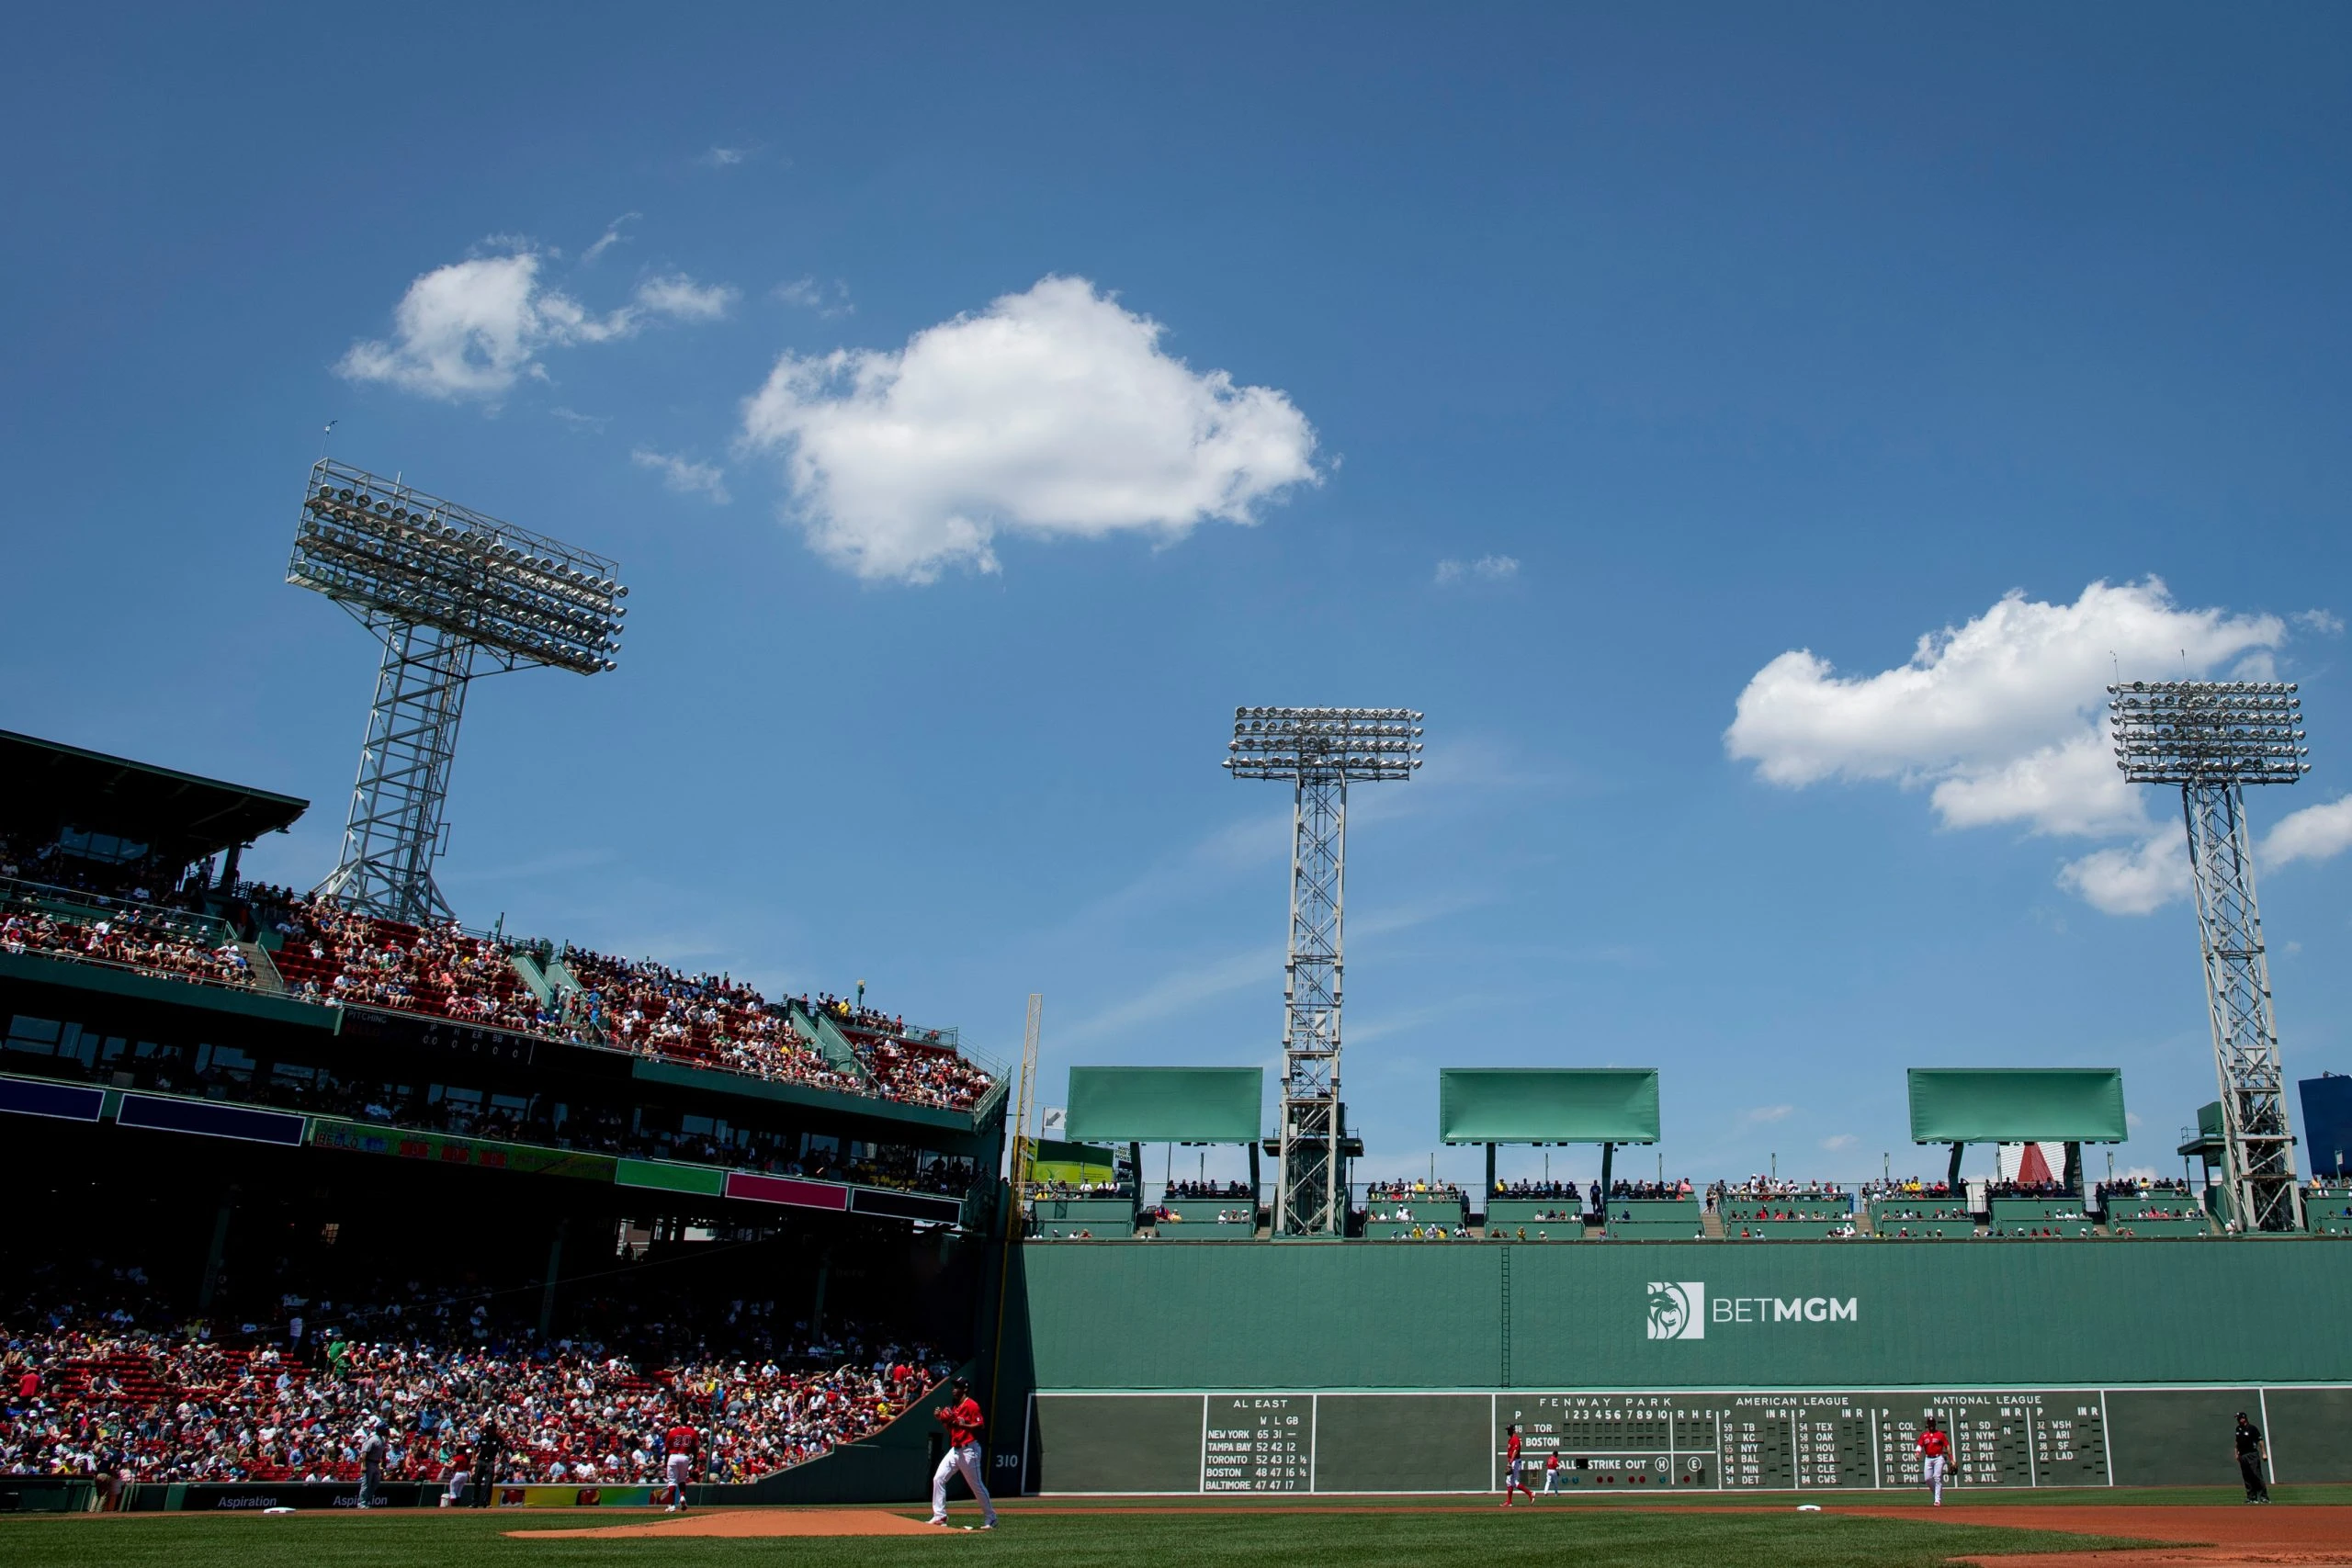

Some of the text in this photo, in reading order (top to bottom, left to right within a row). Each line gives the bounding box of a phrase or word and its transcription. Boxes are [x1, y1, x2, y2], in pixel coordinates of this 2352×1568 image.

[346, 1010, 388, 1024] PITCHING
[471, 1031, 482, 1040] ER
[492, 1034, 503, 1043] BB
[451, 1039, 458, 1049] 0
[471, 1043, 479, 1052] 0
[492, 1046, 499, 1055] 0
[513, 1049, 519, 1058] 0
[1713, 1298, 1857, 1322] BETMGM
[1540, 1398, 1670, 1406] FENWAY PARK
[1736, 1397, 1849, 1405] AMERICAN LEAGUE
[1934, 1396, 1990, 1404] NATIONAL
[1516, 1410, 1711, 1419] P 1 2 3 4 5 6 7 8 9 10 R H E
[1724, 1410, 1730, 1418] P
[1781, 1409, 1786, 1417] R
[1800, 1409, 1862, 1417] P IN R
[1883, 1409, 1888, 1417] P
[1924, 1408, 1933, 1418] IN
[1961, 1408, 2021, 1416] P IN R
[2037, 1407, 2098, 1416] P IN R
[1261, 1416, 1298, 1425] W L GB
[1534, 1424, 1552, 1432] TOR
[1743, 1423, 1755, 1431] TB
[1799, 1423, 1807, 1431] 54
[1899, 1422, 1916, 1430] COL
[1979, 1421, 1990, 1429] SD
[2037, 1421, 2045, 1429] 32
[1208, 1430, 1282, 1438] NEW YORK 65 31
[1800, 1433, 1833, 1441] 58 OAK
[1900, 1432, 1916, 1440] MIL
[1961, 1432, 1969, 1440] 59
[673, 1435, 692, 1447] 20
[1526, 1438, 1559, 1447] BOSTON
[1208, 1442, 1295, 1451] TAMPA BAY 52 42 12
[1741, 1444, 1758, 1452] NYY
[1900, 1443, 1916, 1451] STL
[1979, 1442, 1994, 1450] MIA
[2058, 1441, 2069, 1450] SF
[1257, 1455, 1267, 1464] 52
[1271, 1455, 1282, 1463] 43
[1287, 1455, 1295, 1463] 12
[1741, 1454, 1758, 1462] BAL
[1817, 1454, 1835, 1462] SEA
[1902, 1453, 1917, 1461] CIN
[1980, 1452, 1994, 1461] PIT
[2040, 1451, 2073, 1461] 22 LAD
[996, 1455, 1017, 1467] 310
[1528, 1461, 1543, 1470] BAT
[1557, 1461, 1576, 1470] ALL
[1589, 1461, 1621, 1470] STRIKE
[1626, 1461, 1645, 1470] OUT
[1659, 1461, 1665, 1469] H
[1692, 1461, 1697, 1469] E
[1743, 1465, 1758, 1473] MIN
[1901, 1464, 1919, 1472] CHC
[1980, 1463, 1996, 1472] LAA
[1206, 1468, 1241, 1476] BOSTON
[1256, 1468, 1267, 1476] 48
[1271, 1468, 1281, 1476] 47
[1286, 1468, 1295, 1476] 16
[1726, 1476, 1734, 1484] 51
[1817, 1475, 1836, 1483] CWS
[1904, 1474, 1918, 1483] PHI
[1943, 1474, 1949, 1483] 0
[1981, 1473, 1996, 1482] ATL
[1205, 1481, 1294, 1489] BALTIMORE 47 47 17
[218, 1496, 277, 1509] Aspiration
[334, 1495, 387, 1507] Aspiion
